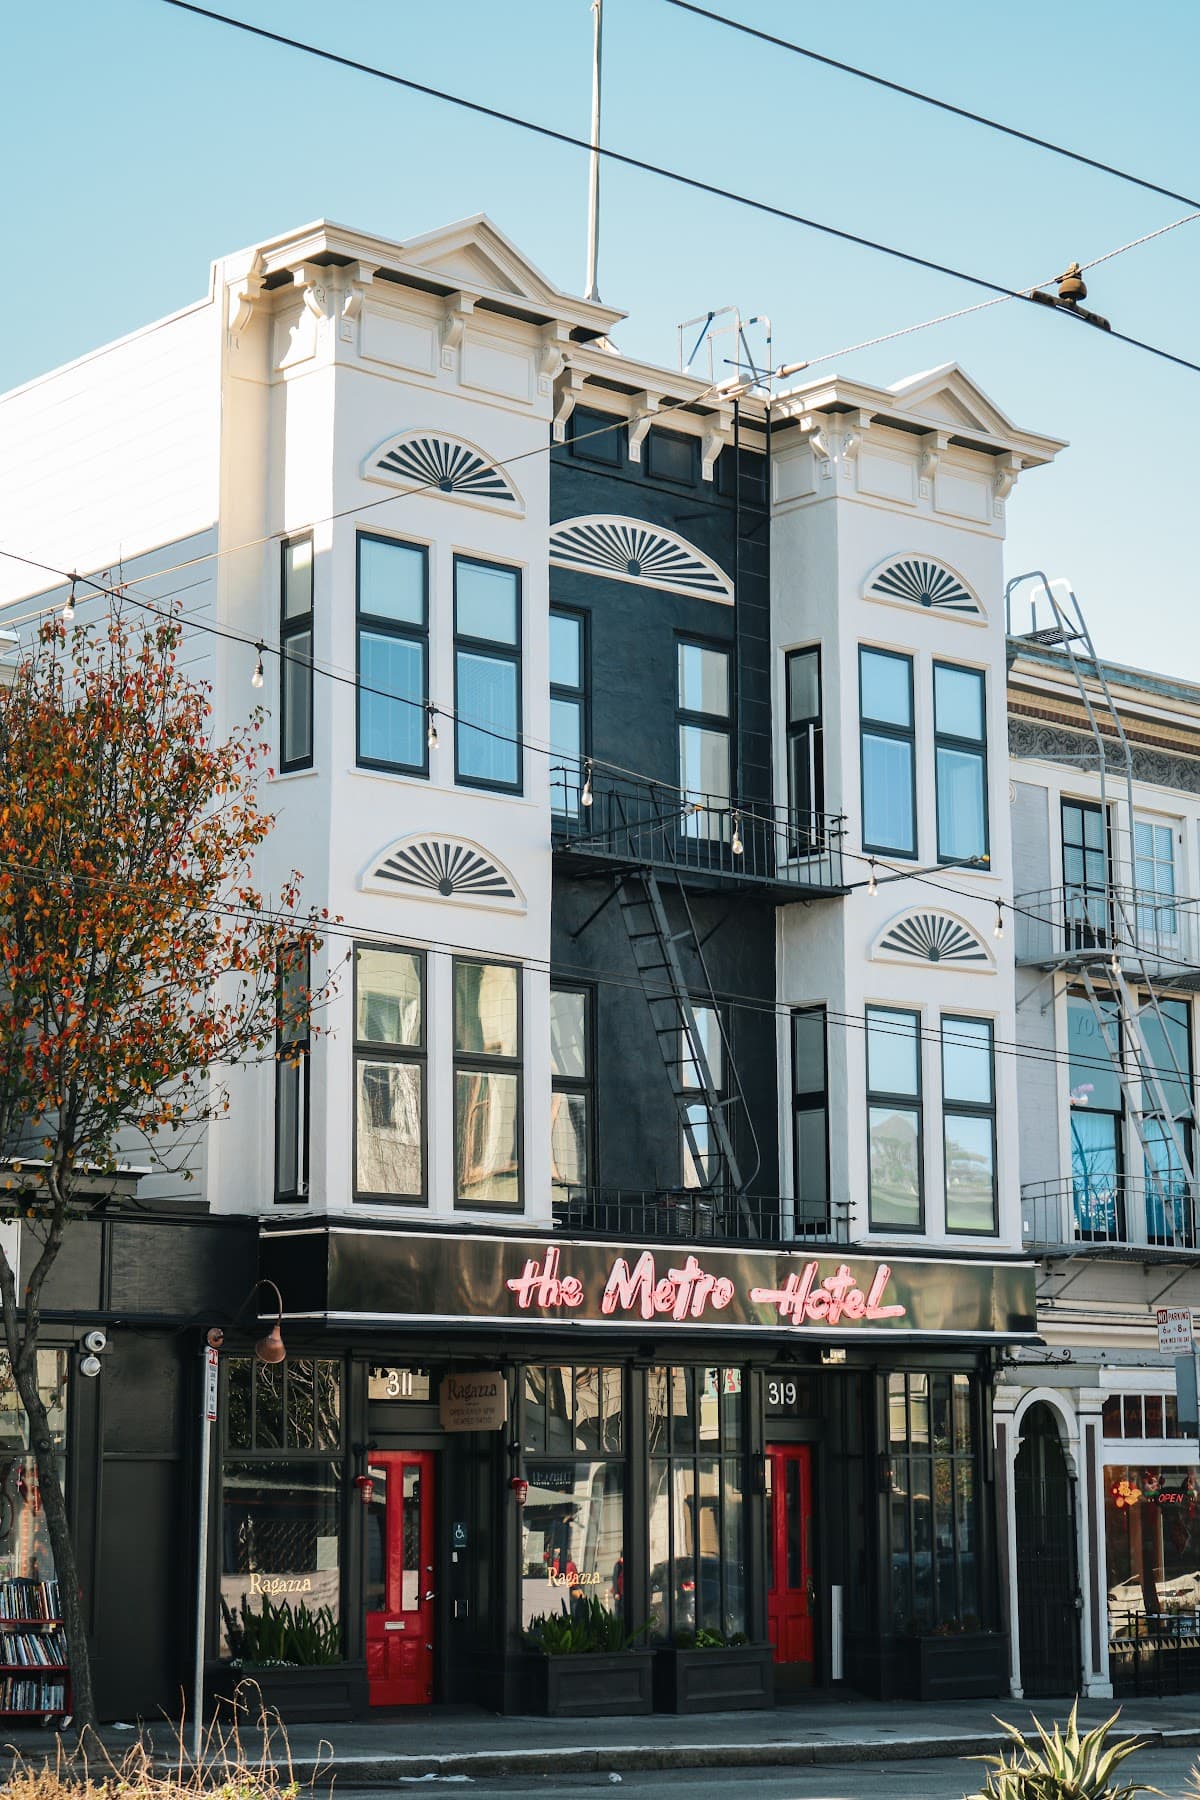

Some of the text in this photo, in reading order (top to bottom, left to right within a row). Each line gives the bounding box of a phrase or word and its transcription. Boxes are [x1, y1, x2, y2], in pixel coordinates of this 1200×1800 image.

[1158, 1311, 1189, 1323] NO PARKING
[385, 1370, 413, 1397] 311
[447, 1378, 498, 1403] Ragazza
[768, 1382, 797, 1405] 319
[1158, 1493, 1184, 1503] OPEN
[249, 1573, 312, 1596] Ragazza
[547, 1566, 600, 1588] Ragazza
